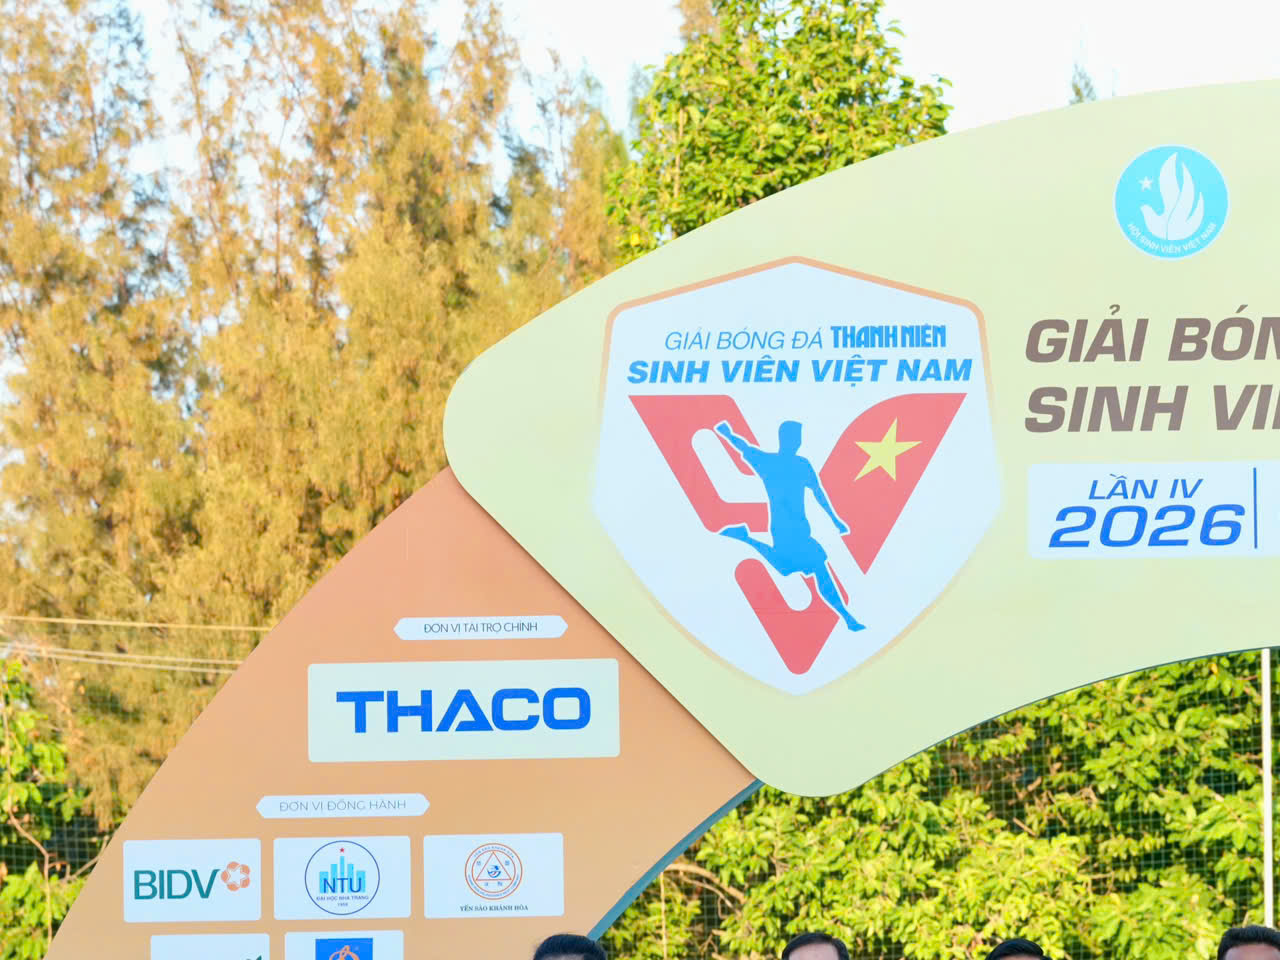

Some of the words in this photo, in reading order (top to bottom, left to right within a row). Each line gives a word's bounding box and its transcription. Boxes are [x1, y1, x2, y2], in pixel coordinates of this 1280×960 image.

[664, 326, 711, 351] GIẢI
[715, 326, 785, 350] BÓNG
[791, 325, 823, 349] ĐÁ
[830, 325, 897, 348] THANH
[900, 322, 946, 348] NIÊN
[1024, 303, 1149, 363] GIẢI
[627, 360, 710, 384] SINH
[721, 355, 801, 383] VIÊN
[811, 355, 888, 387] VIỆT
[896, 358, 973, 382] NAM
[1024, 383, 1186, 433] SINH
[1088, 472, 1161, 500] LẦN
[1169, 477, 1203, 499] IV
[1048, 503, 1246, 548] 2026
[504, 620, 537, 632] CHÍNH
[336, 687, 592, 734] THACO
[279, 801, 308, 812] ĐƠN
[369, 799, 406, 809] HÀNH
[134, 869, 221, 900] BIDV
[323, 877, 362, 893] NTU
